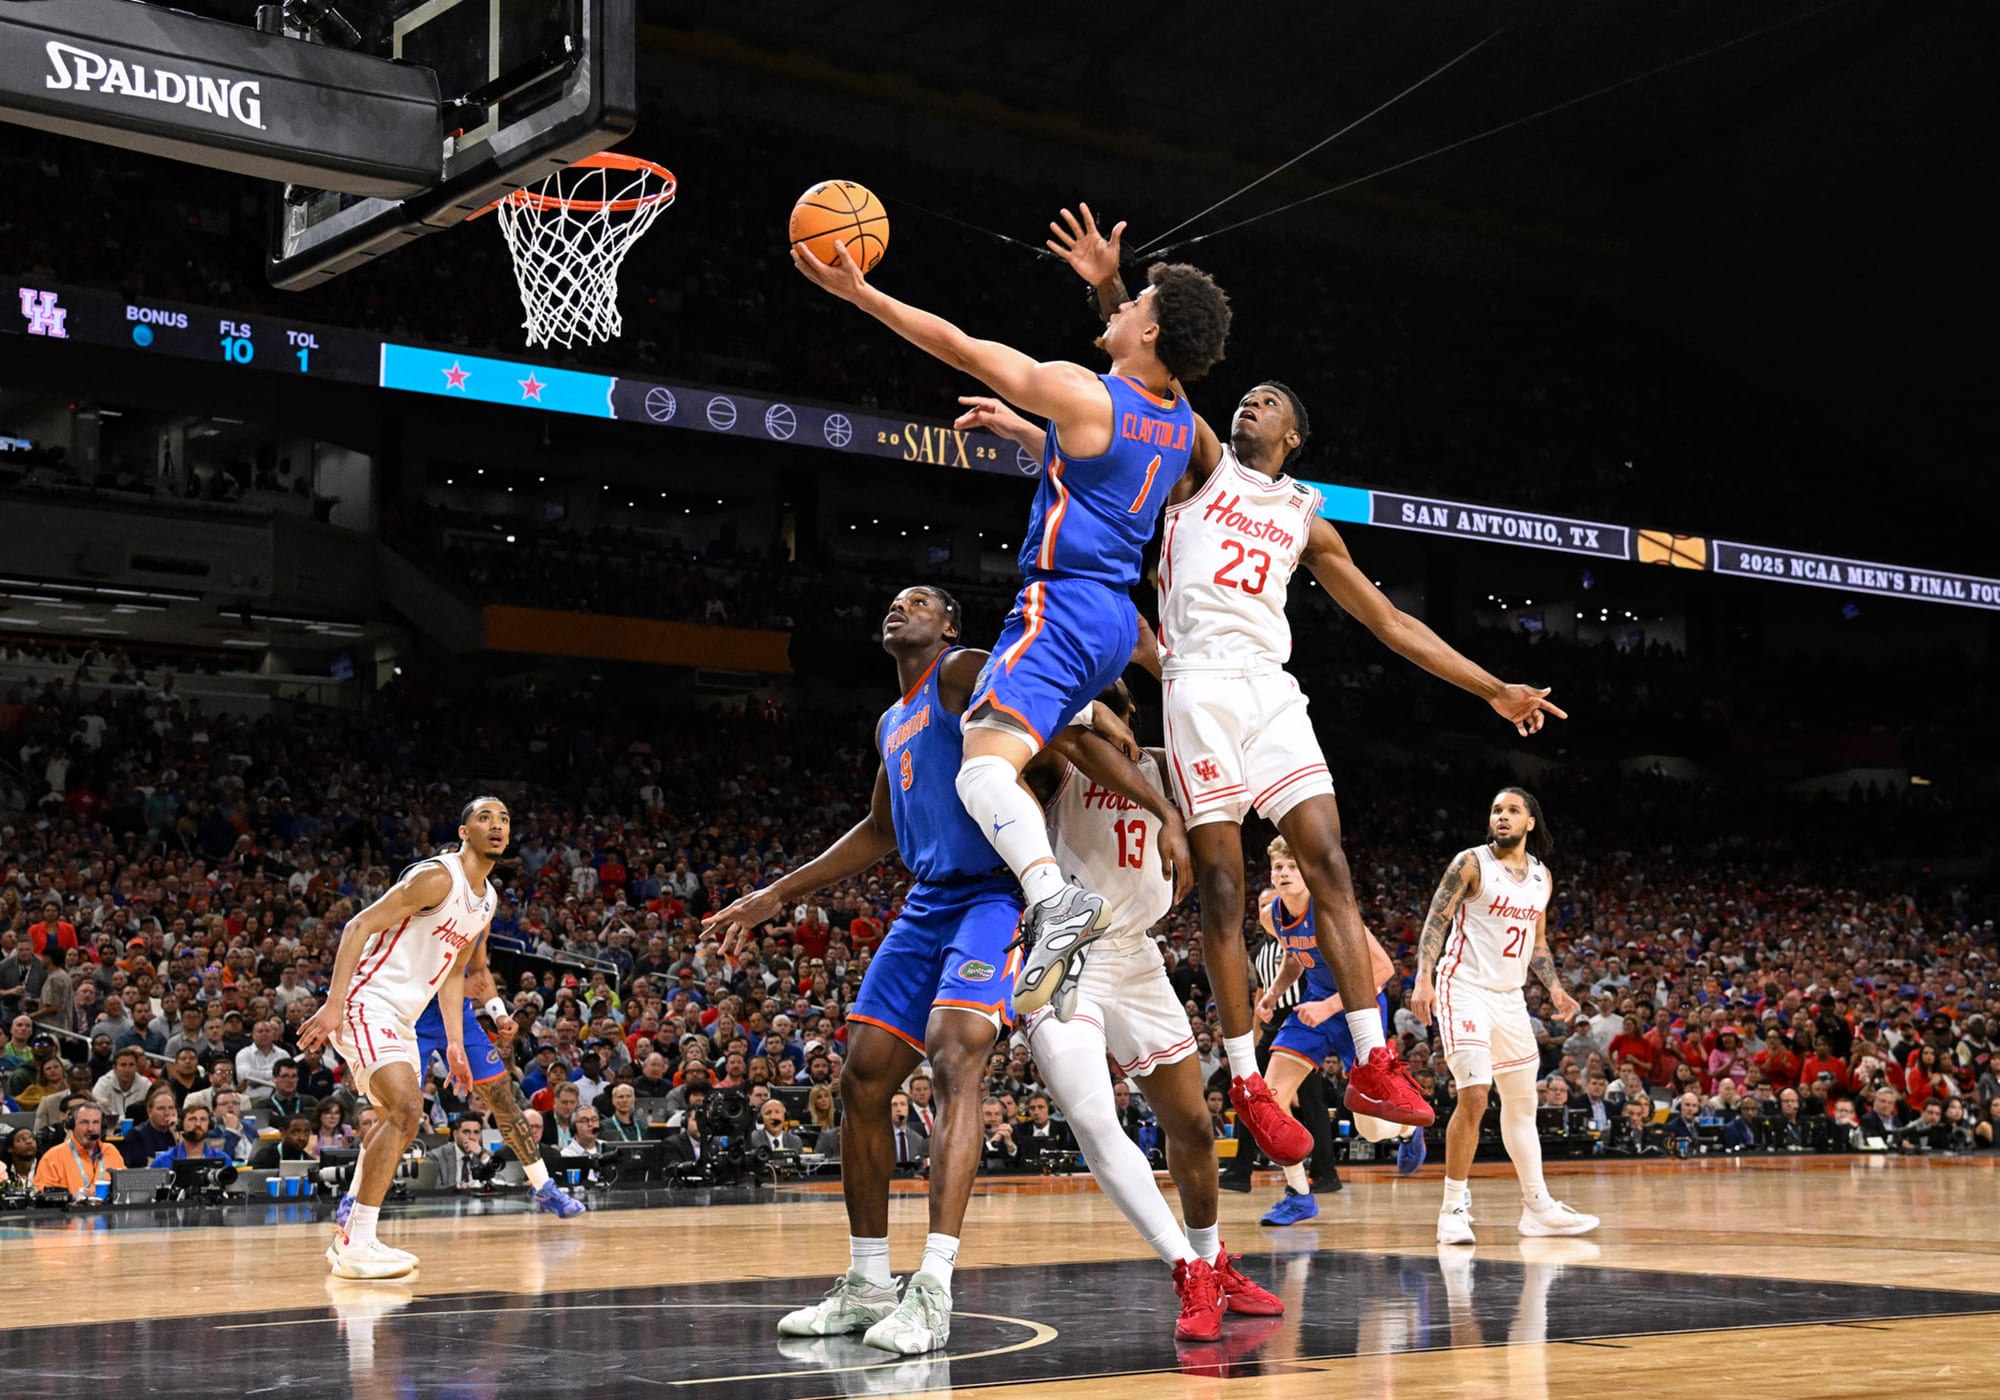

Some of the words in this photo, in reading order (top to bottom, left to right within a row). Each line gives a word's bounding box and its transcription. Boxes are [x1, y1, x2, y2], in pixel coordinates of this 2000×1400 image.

[46, 40, 262, 129] SPALDING
[126, 305, 188, 328] BONUS
[220, 320, 251, 338] FLS
[221, 336, 254, 364] 10
[287, 331, 319, 349] TOL
[296, 348, 309, 373] 1
[903, 422, 971, 469] SATX
[1121, 412, 1175, 447] CLAYTON
[1127, 454, 1162, 514] 1
[1203, 490, 1294, 550] Houston
[1402, 503, 1448, 527] SAN
[1456, 511, 1562, 546] ANTONIO,
[1570, 526, 1599, 548] TX
[1213, 539, 1271, 595] 23
[1740, 552, 1784, 574] 2025
[1790, 558, 1841, 582] NCAA
[1847, 566, 1904, 591] MEN'S
[1910, 574, 1965, 599] FINAL
[883, 704, 930, 761] FLORIDA
[900, 748, 914, 791] 9
[1114, 818, 1147, 869] 13
[1488, 895, 1542, 921] Housto
[1503, 926, 1528, 958] 21
[429, 952, 452, 985] 7
